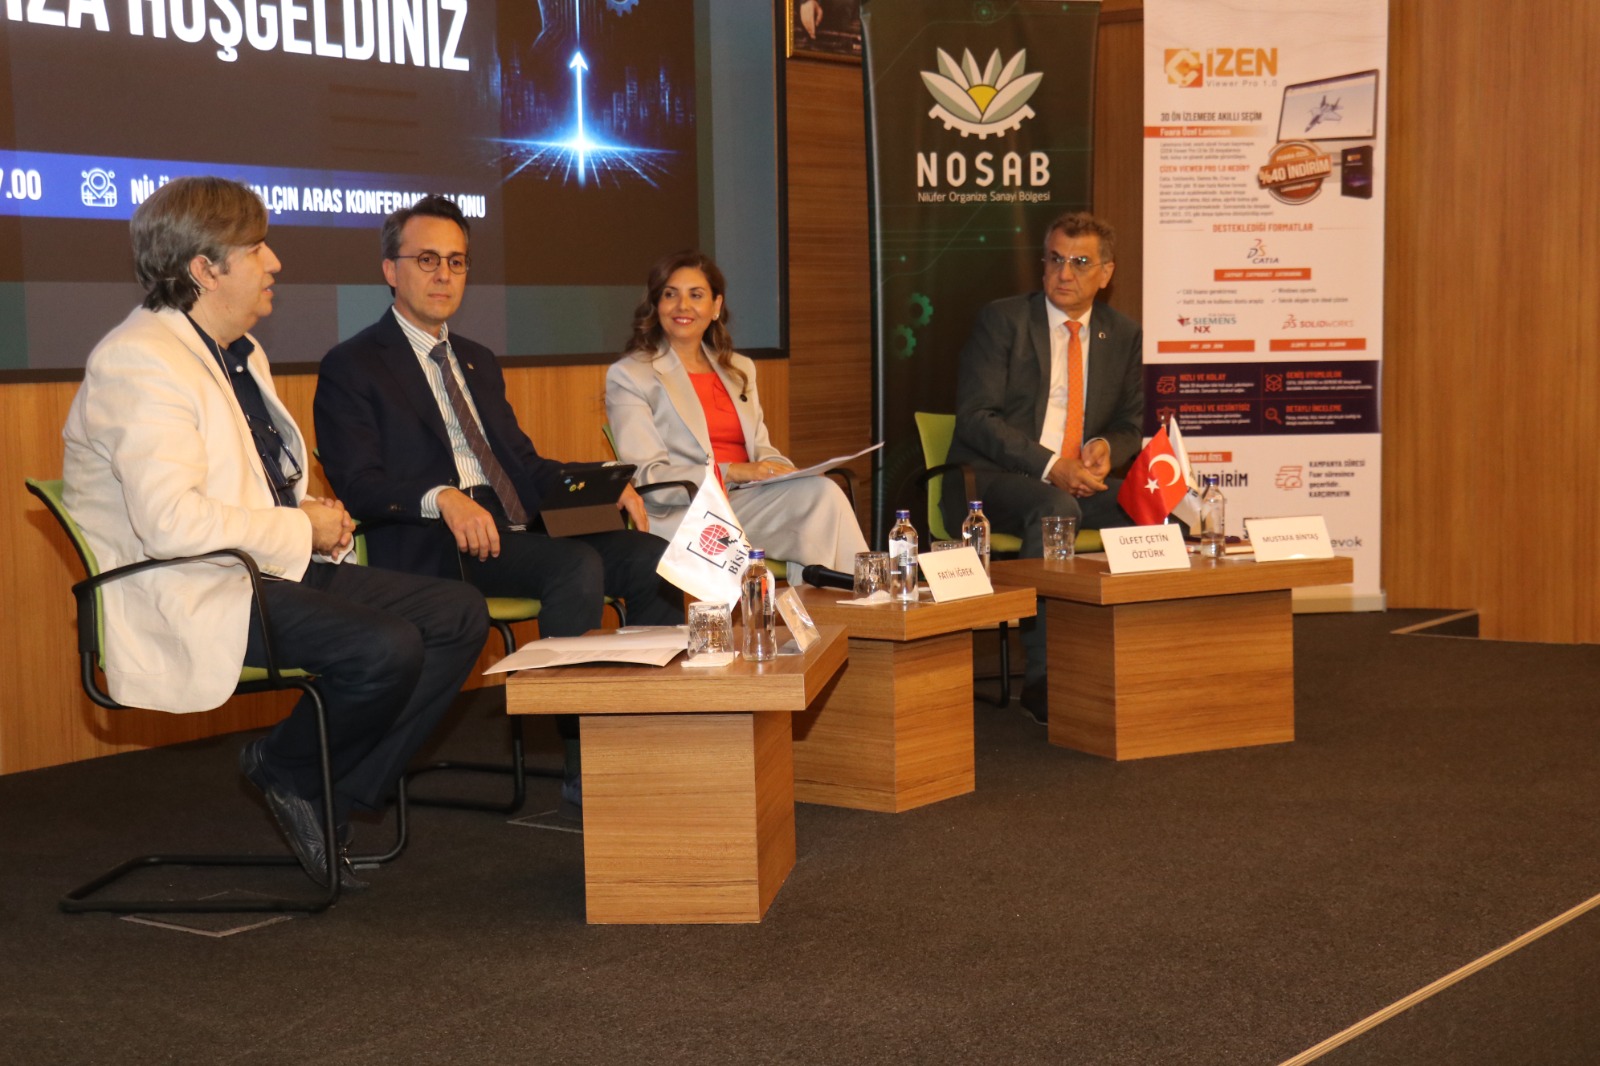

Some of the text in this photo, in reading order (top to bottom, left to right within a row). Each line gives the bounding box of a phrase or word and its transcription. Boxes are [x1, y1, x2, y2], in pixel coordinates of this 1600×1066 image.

[1218, 112, 1239, 121] AKILLI
[1241, 111, 1262, 122] SEÇİM
[917, 152, 1051, 187] NOSAB
[1287, 158, 1330, 179] İNDİRİM
[0, 168, 42, 201] .00
[251, 183, 299, 215] ALÇIN
[302, 187, 343, 213] ARAS
[918, 191, 1051, 203] Nilüfer Organize Sanayi Bölgesi
[1268, 223, 1313, 231] FORMATLAR
[1193, 316, 1237, 325] SIEMENS
[1194, 326, 1211, 334] NX
[1119, 533, 1169, 545] ÜLFET ÇETİN
[1262, 535, 1295, 543] MUSTAFA
[728, 543, 751, 575] BİSİA
[1132, 548, 1165, 559] ÖZTÜRK
[937, 567, 975, 580] FATİH İĞREK
